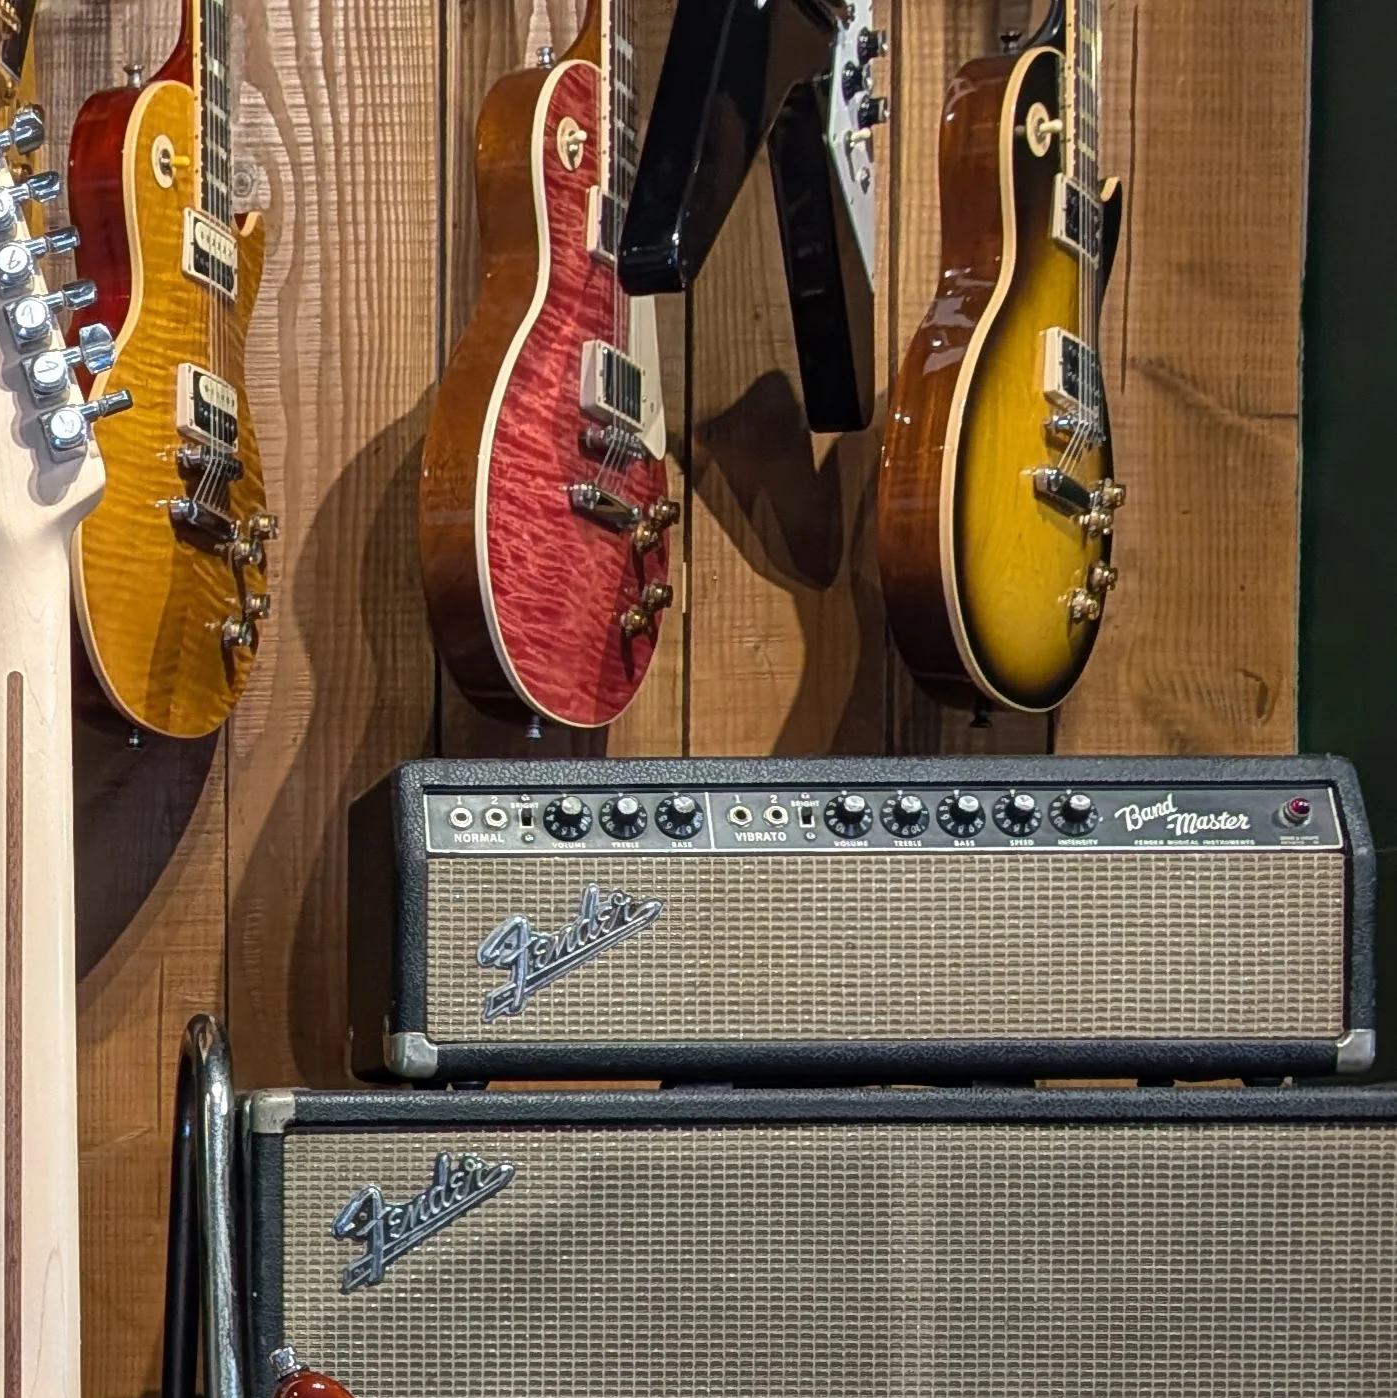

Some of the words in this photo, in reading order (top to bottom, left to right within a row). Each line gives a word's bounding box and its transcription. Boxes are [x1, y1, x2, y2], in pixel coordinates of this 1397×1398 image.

[456, 795, 463, 806] 1
[490, 795, 499, 806] 2
[734, 794, 742, 804] 1
[769, 794, 778, 804] 2
[1114, 792, 1179, 831] Band
[454, 833, 506, 843] NORMAL
[735, 831, 787, 842] VIBRATO
[894, 839, 922, 847] TREBLE
[953, 839, 976, 847] BASS
[1009, 839, 1034, 847] SPEED
[1057, 838, 1099, 846] INTENSITY
[477, 883, 663, 1022] Fender
[332, 1151, 516, 1295] Fender
